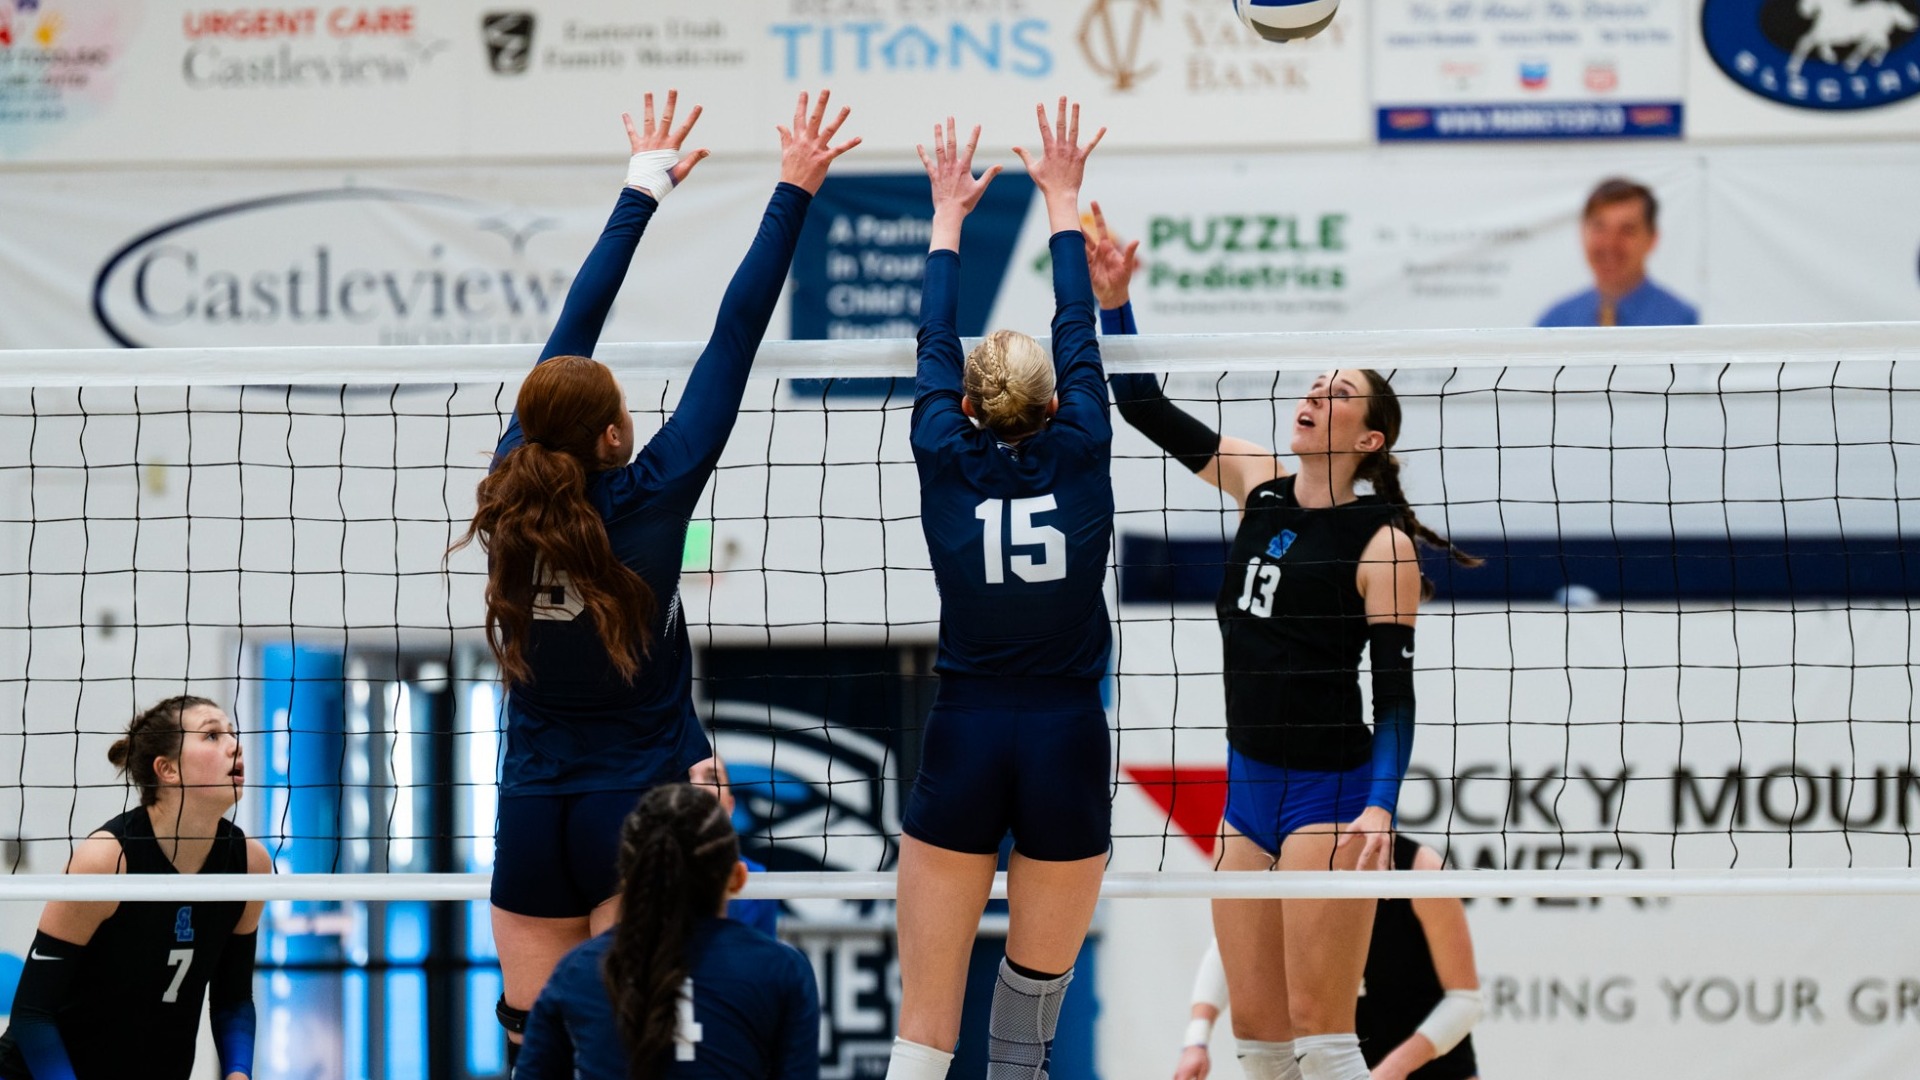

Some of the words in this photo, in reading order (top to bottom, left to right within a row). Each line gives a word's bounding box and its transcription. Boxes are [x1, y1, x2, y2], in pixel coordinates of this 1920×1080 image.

[183, 9, 318, 40] URGENT
[326, 7, 416, 38] CARE
[665, 17, 723, 39] Utah
[182, 41, 408, 89] Castleview
[767, 19, 1054, 79] TITANS
[1186, 54, 1308, 92] BANK
[827, 214, 854, 245] A
[857, 213, 932, 246] Partn
[1150, 214, 1348, 252] PUZZLE
[134, 244, 570, 326] Castleview
[826, 251, 859, 281] In
[1150, 260, 1347, 289] Pediatrics
[975, 493, 1067, 584] 15
[1237, 556, 1282, 618] 13
[1394, 763, 1632, 828] OCKY
[161, 947, 195, 1003] 7
[1659, 974, 1826, 1026] YOUR
